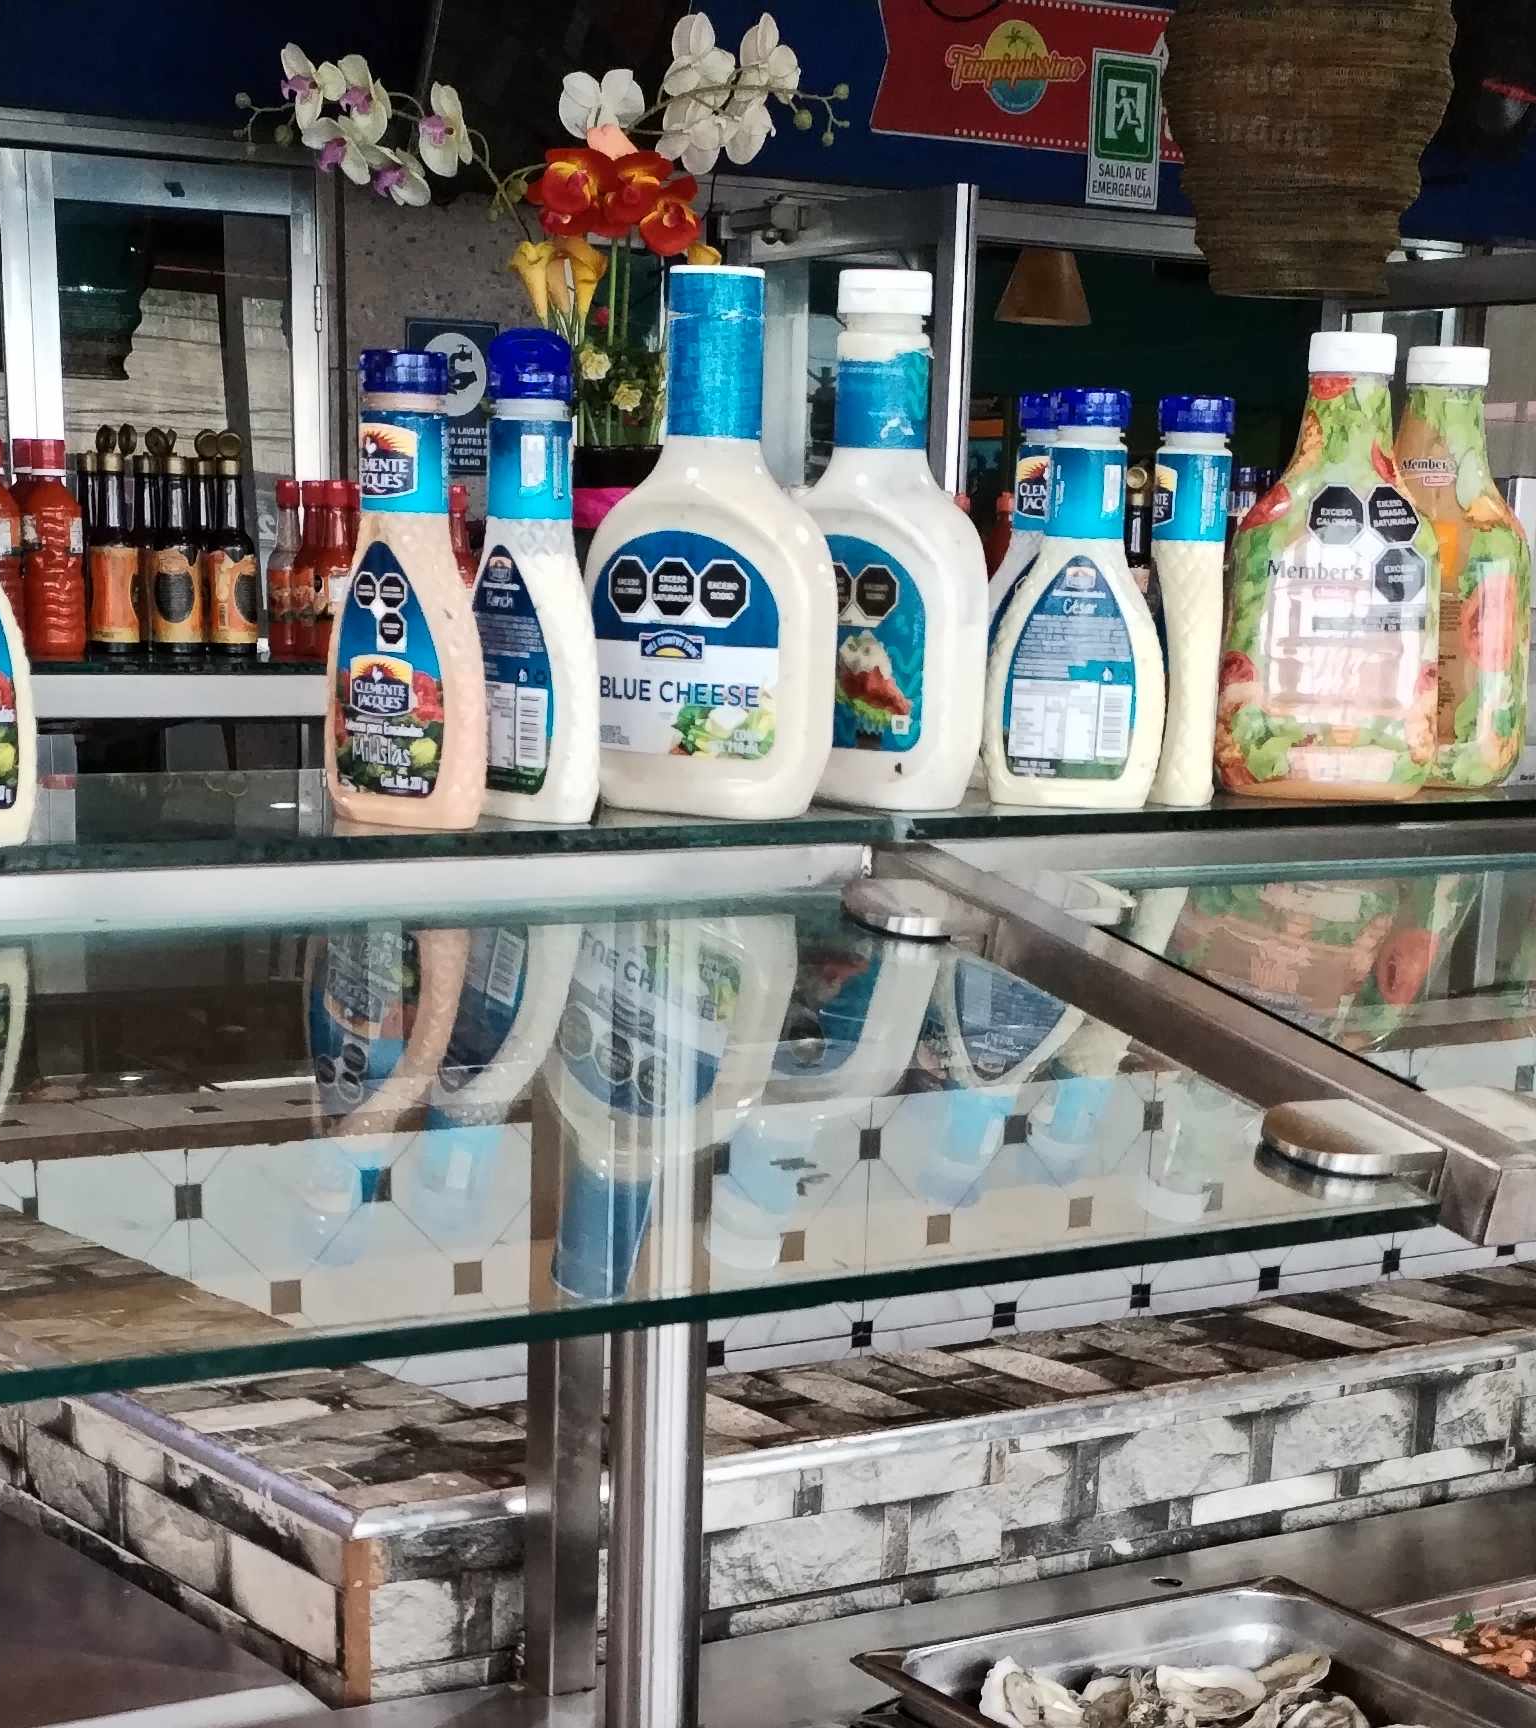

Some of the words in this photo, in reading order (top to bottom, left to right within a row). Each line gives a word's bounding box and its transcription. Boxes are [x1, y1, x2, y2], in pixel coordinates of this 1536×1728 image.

[1098, 163, 1132, 180] SALIDA
[1134, 167, 1148, 182] DE
[1091, 179, 1152, 199] EMERGENCIA
[1320, 508, 1353, 517] EXCESO
[1373, 517, 1417, 528] SATURADAS
[1266, 560, 1363, 580] Member's
[353, 679, 407, 699] CLEMENTE
[599, 675, 652, 702] BLUE
[659, 680, 760, 708] CHEESE
[357, 694, 405, 714] JACQUES
